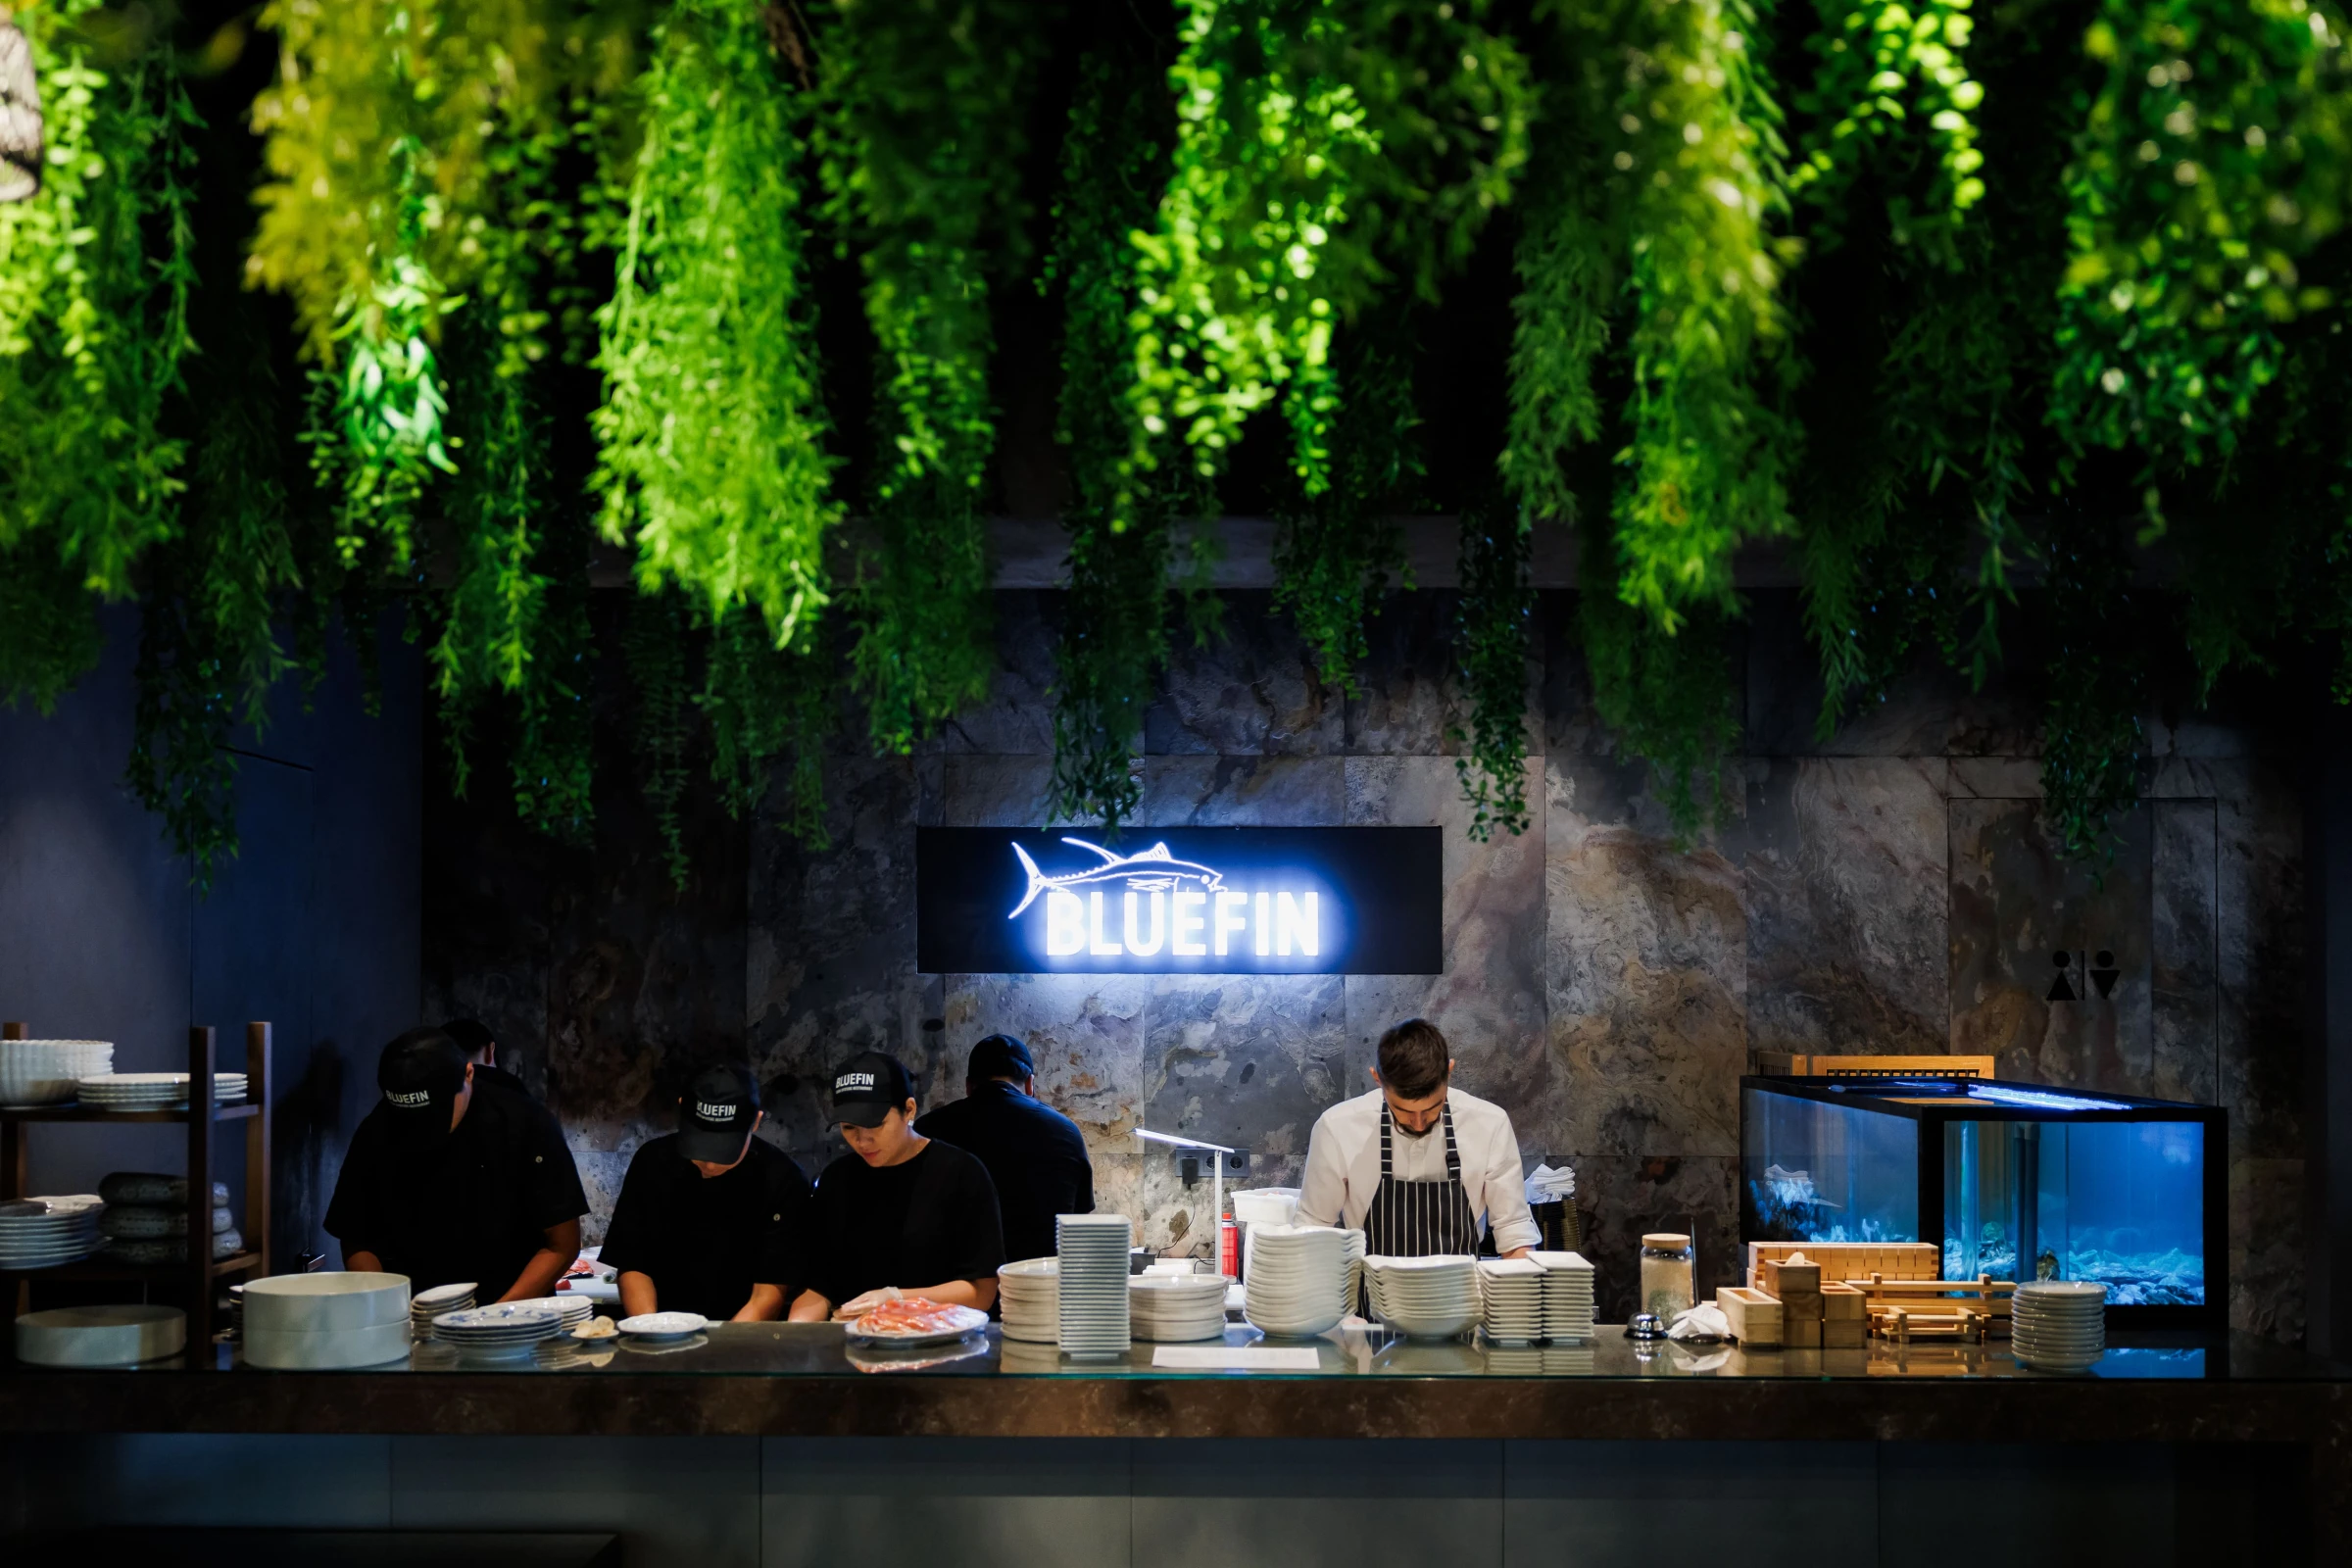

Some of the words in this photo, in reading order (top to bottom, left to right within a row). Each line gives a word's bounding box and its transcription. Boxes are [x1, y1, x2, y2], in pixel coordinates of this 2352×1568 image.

[1047, 891, 1319, 956] BLUEFIN
[835, 1072, 874, 1089] BLUEFIN
[385, 1089, 429, 1104] BLUEFIN
